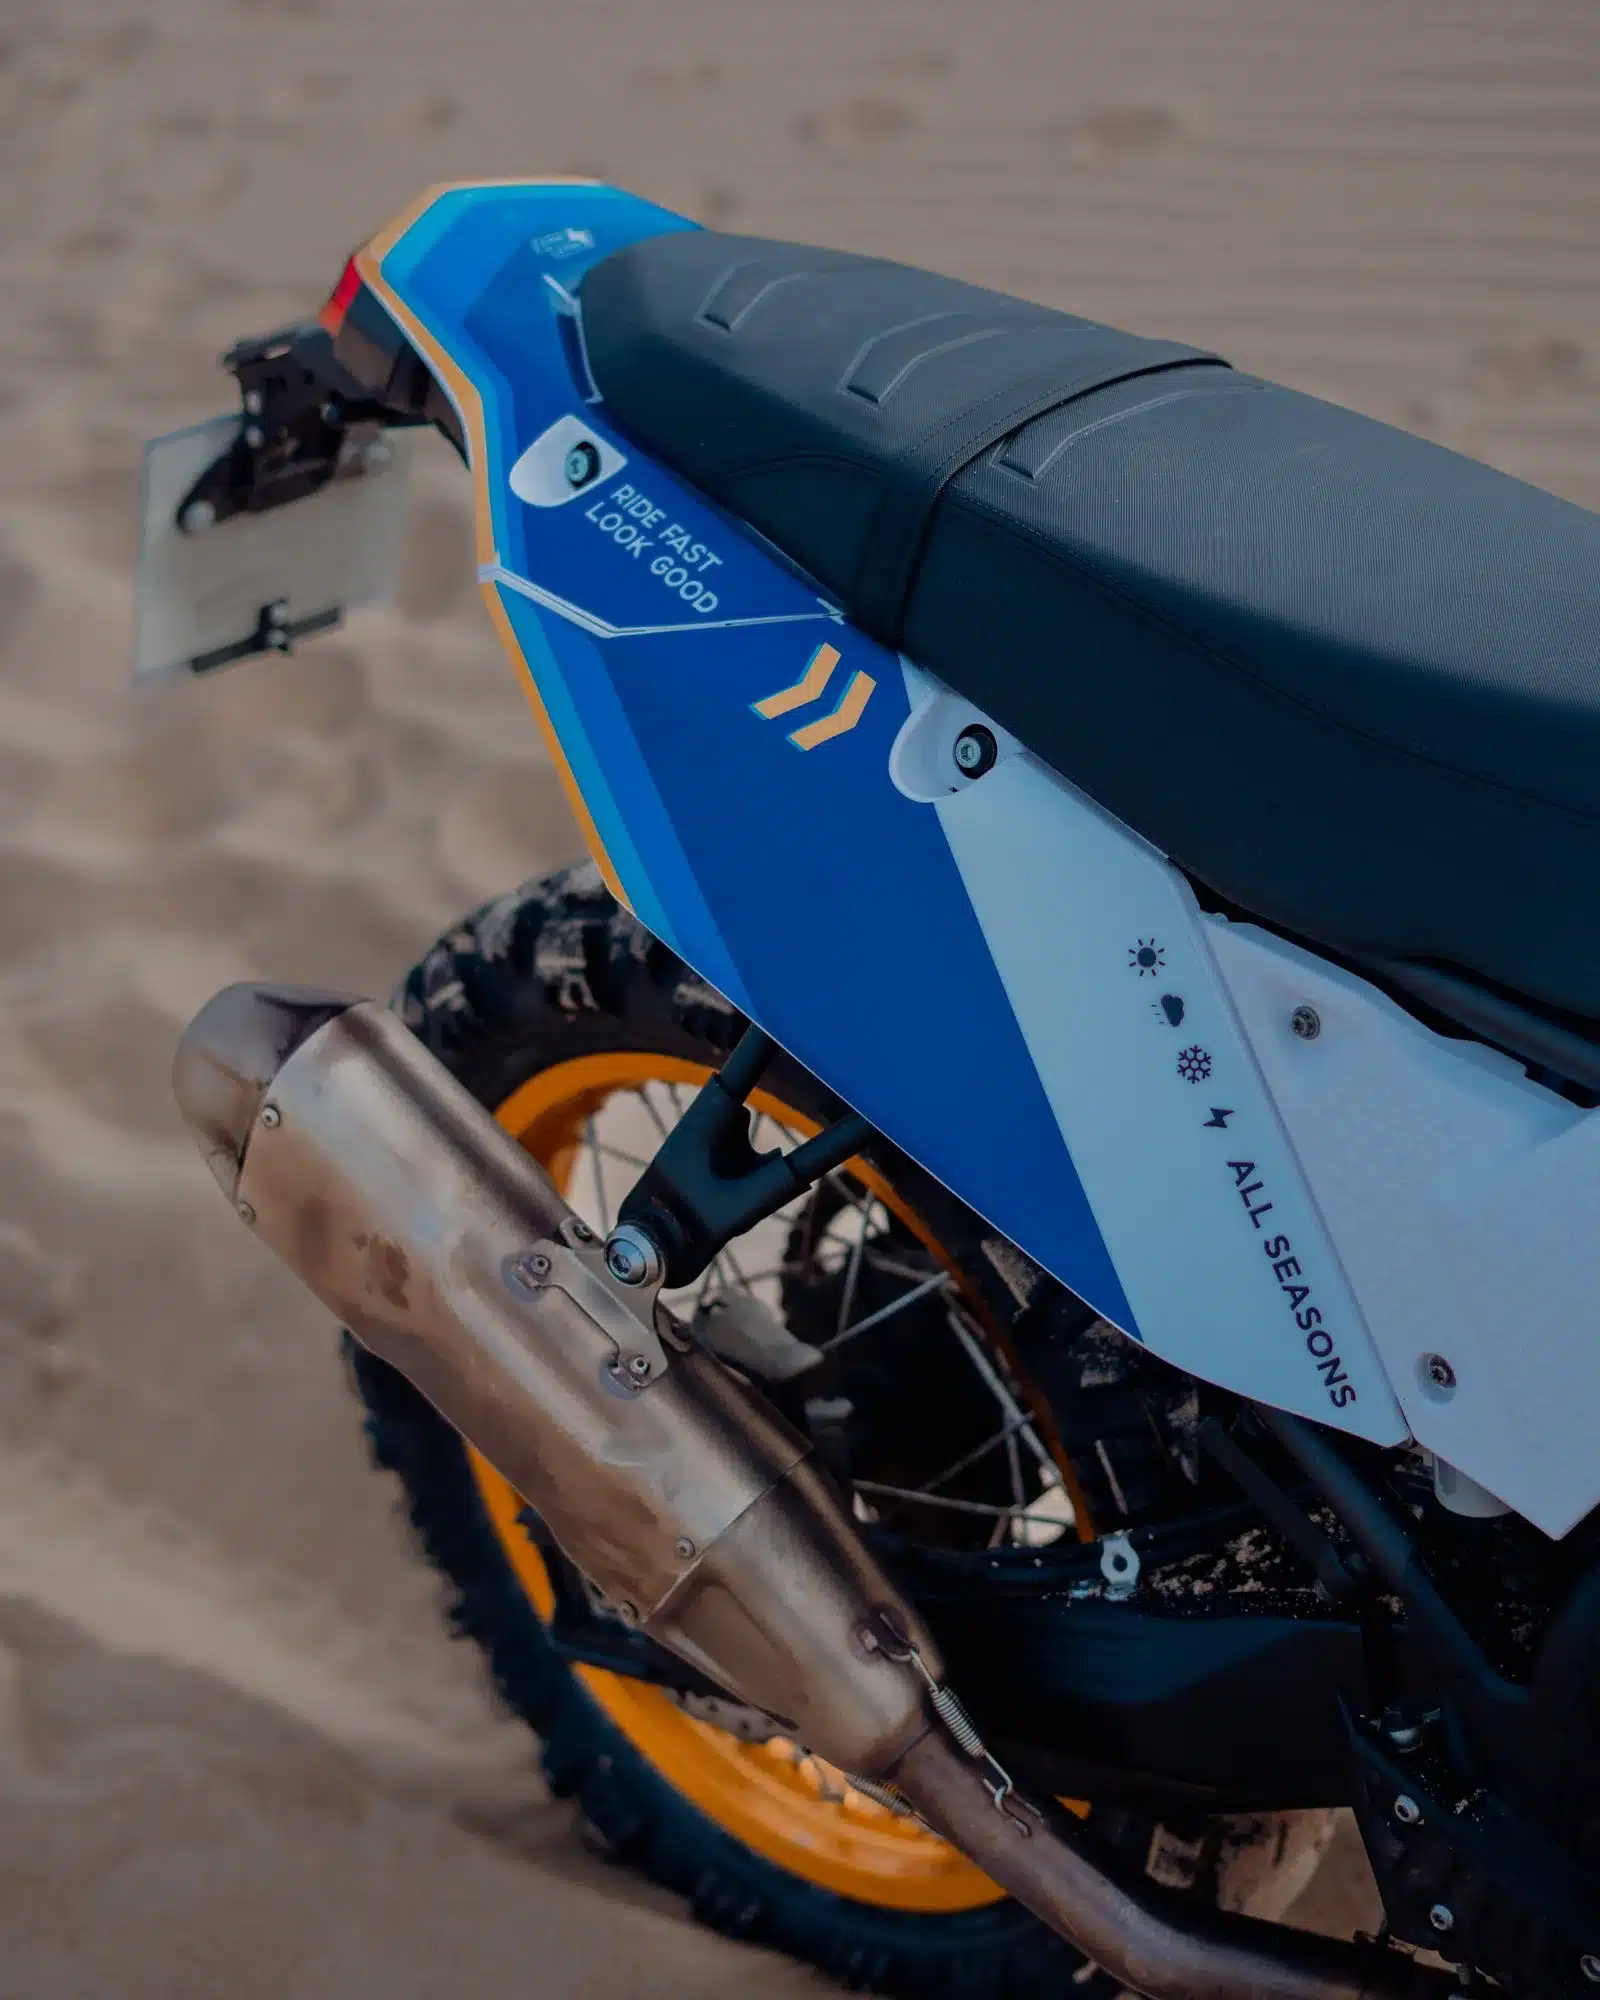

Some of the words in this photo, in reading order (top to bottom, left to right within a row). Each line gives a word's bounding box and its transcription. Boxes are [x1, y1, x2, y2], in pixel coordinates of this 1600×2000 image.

[585, 502, 654, 560] LOOK
[650, 555, 719, 614] GOOD
[611, 484, 666, 530] RIDE
[659, 518, 723, 573] FAST
[1226, 1160, 1273, 1230] ALL
[1264, 1234, 1356, 1408] SEASONS
